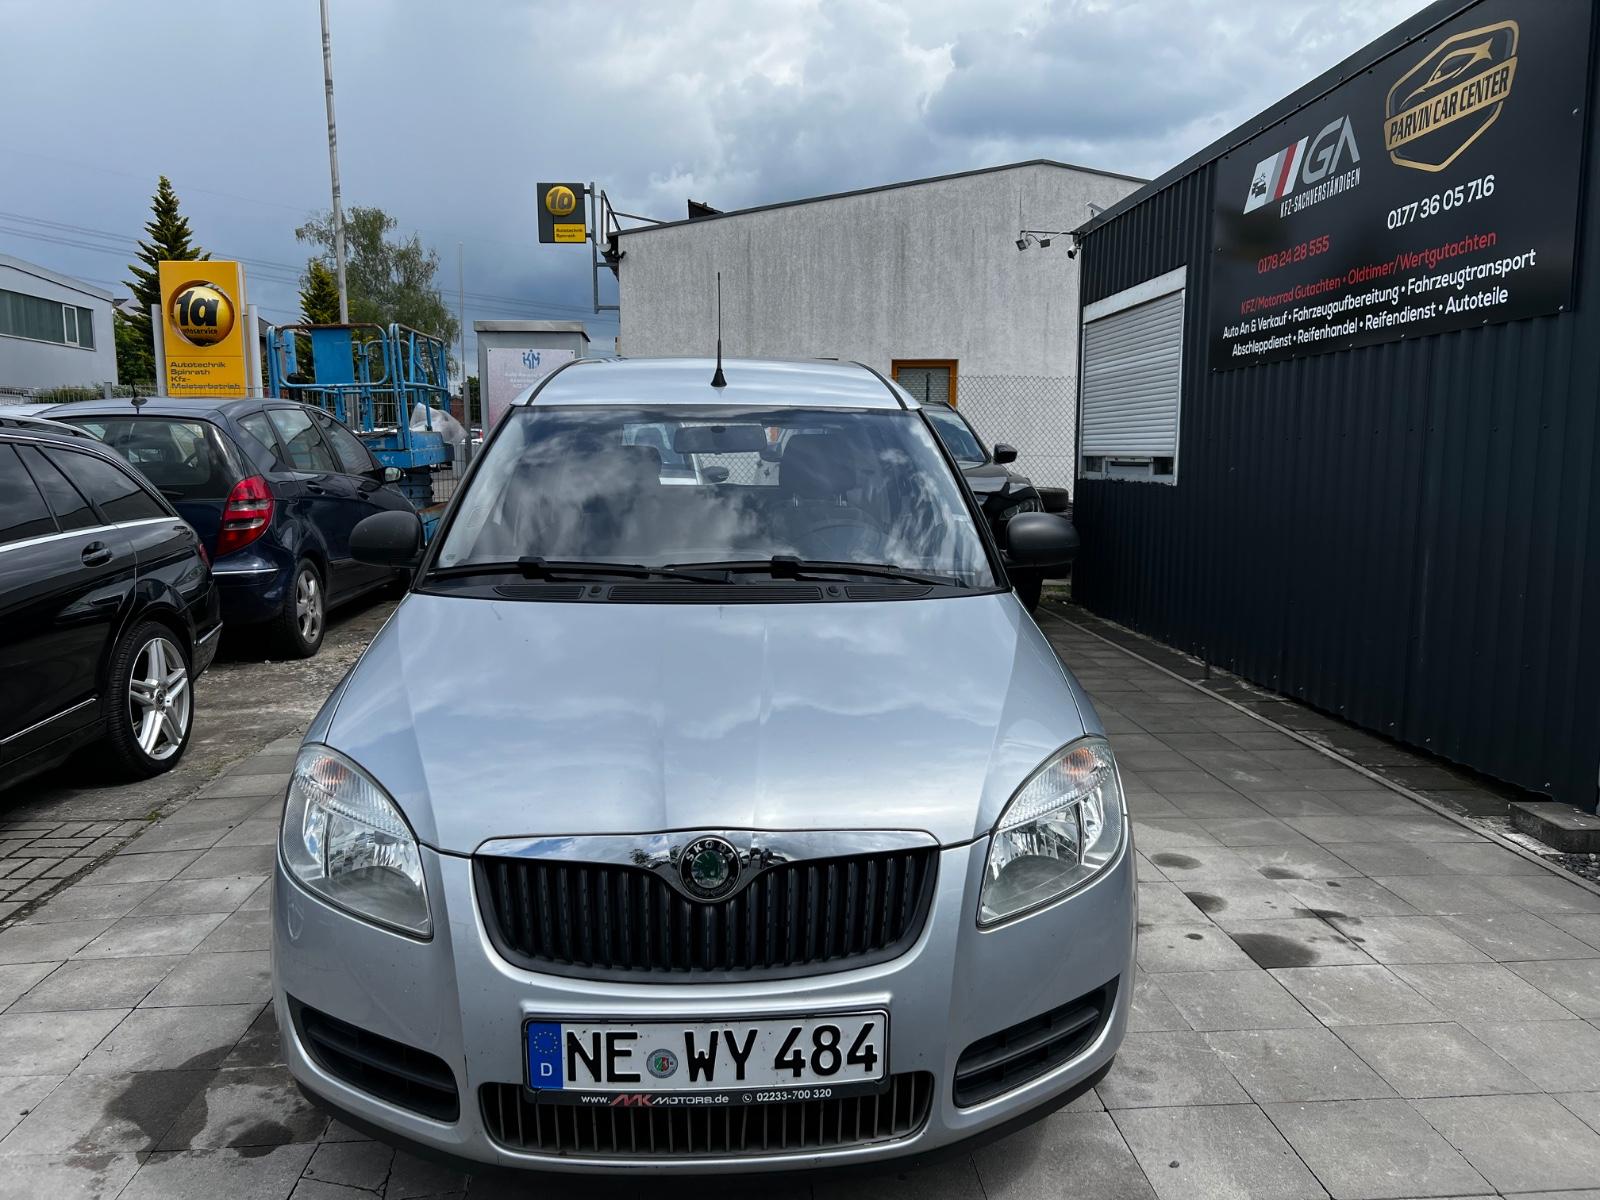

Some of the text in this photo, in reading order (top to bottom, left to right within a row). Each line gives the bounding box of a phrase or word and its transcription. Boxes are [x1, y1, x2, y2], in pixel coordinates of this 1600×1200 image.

[1389, 65, 1510, 145] PARVIN CAR CENTER
[549, 188, 573, 210] 1a
[1280, 167, 1360, 218] KFZ-SACHVERSTÄNDIGEN
[1387, 174, 1495, 230] 0177 36 05 716
[1240, 231, 1496, 315] KFZ/Motorrad Gutachten Oldtimer/Wertgutachten
[1257, 235, 1330, 274] 0178 24 28 555
[176, 290, 219, 326] 1a
[1223, 248, 1536, 339] Auto An & Verkauf Fahrzeugaufbereitung Fahrzeugtransport
[1232, 286, 1509, 356] Abschleppdienst Reifenhandel Reifendienst Autoteile
[540, 1063, 552, 1076] D
[567, 1032, 641, 1082] NE
[684, 1029, 758, 1082] WY
[774, 1023, 877, 1077] 484
[757, 1090, 811, 1102] 02233-700
[813, 1089, 832, 1098] 320
